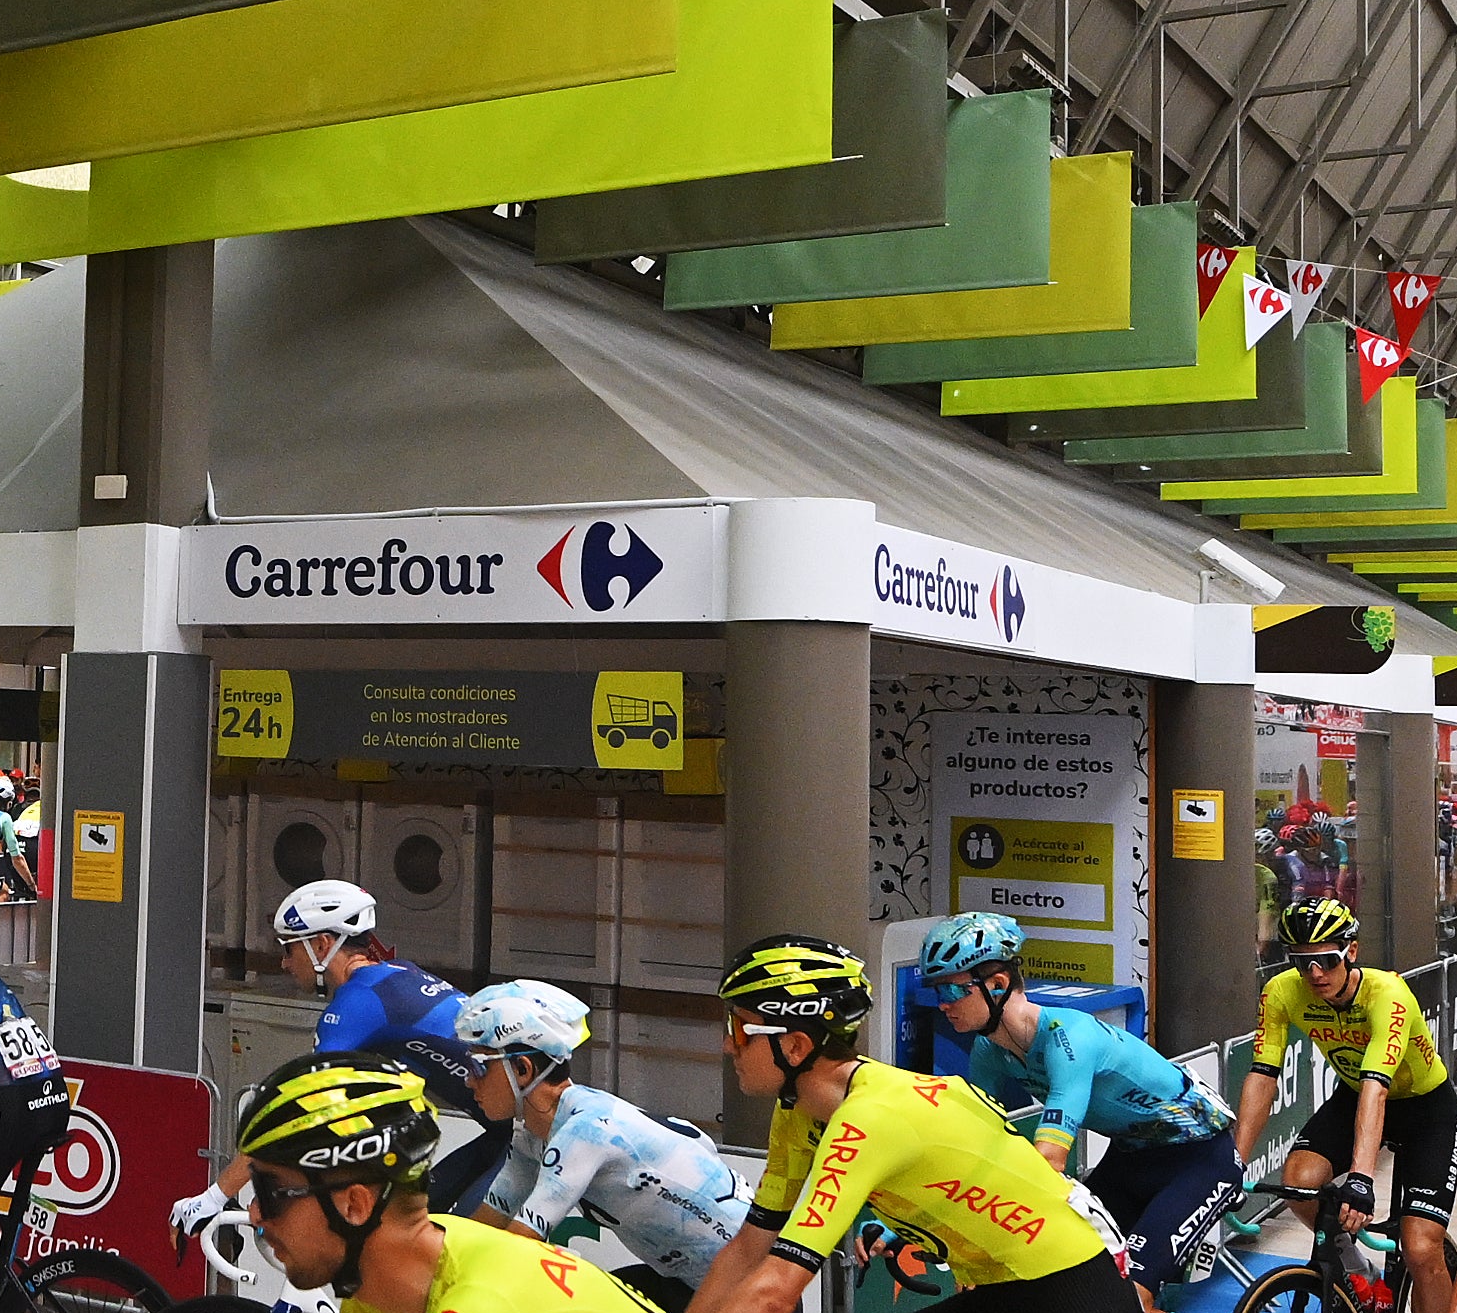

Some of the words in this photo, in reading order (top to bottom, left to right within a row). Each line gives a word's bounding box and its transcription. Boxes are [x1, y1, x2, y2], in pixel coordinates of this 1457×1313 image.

[225, 538, 504, 600] Carrefour
[874, 543, 980, 620] Carrefour
[223, 688, 283, 705] Entrega
[363, 683, 426, 701] Consulta
[429, 684, 516, 702] condiciones
[221, 707, 282, 739] 24h
[370, 710, 388, 723] en
[391, 708, 412, 724] los
[416, 709, 508, 725] mostradores
[362, 731, 380, 747] de
[384, 731, 447, 748] Atención
[451, 732, 464, 748] al
[468, 733, 520, 750] Cliente
[966, 726, 999, 749] ¿Te
[1006, 728, 1092, 746] interesa
[945, 752, 1017, 776] alguno
[1023, 754, 1049, 771] de
[1055, 757, 1114, 775] estos
[969, 779, 1089, 800] productos?
[1011, 837, 1068, 852] Acércate
[1072, 839, 1085, 852] al
[1011, 851, 1081, 866] mostrador
[1084, 854, 1100, 866] de
[990, 887, 1065, 909] Electro
[1027, 956, 1086, 973] llámanos
[1, 1028, 34, 1061] 58
[1307, 1027, 1372, 1044] ARKEA
[1382, 1001, 1407, 1066] ARKEA
[1413, 1033, 1437, 1071] ARKEA
[796, 1121, 867, 1231] ARKEA
[30, 1205, 48, 1229] 58
[655, 1186, 713, 1228] Telefónica
[923, 1178, 1046, 1246] ARKEA
[1169, 1180, 1232, 1256] ASTANA
[1193, 1241, 1217, 1273] 198
[32, 1266, 56, 1286] SWISS
[56, 1260, 77, 1276] SIDE
